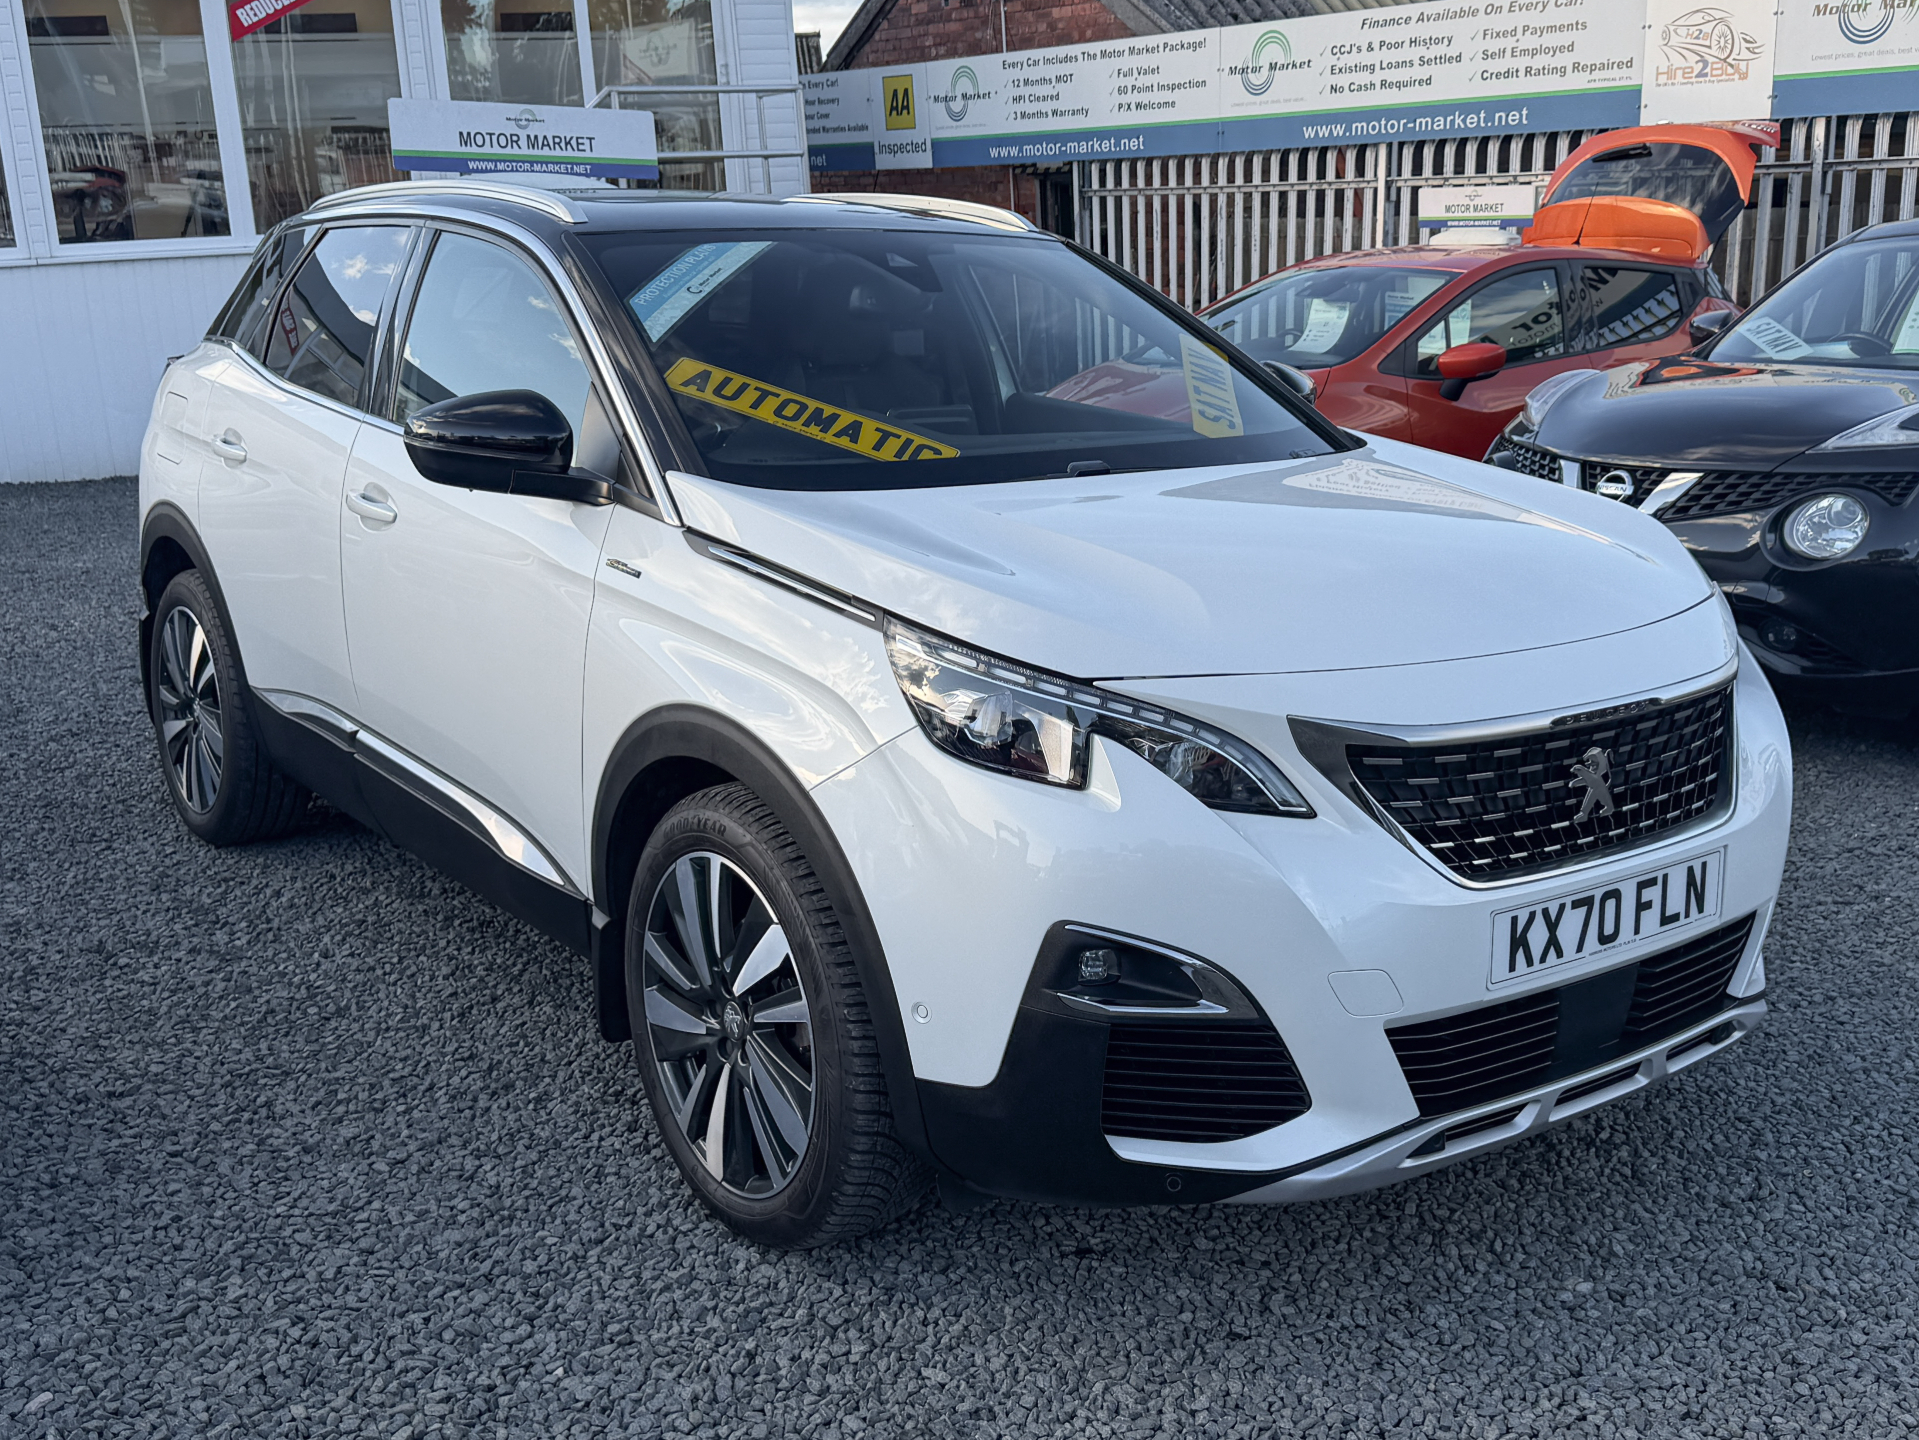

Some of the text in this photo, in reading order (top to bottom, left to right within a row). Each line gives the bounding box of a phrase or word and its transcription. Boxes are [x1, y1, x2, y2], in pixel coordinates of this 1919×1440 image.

[1361, 15, 1412, 30] Finance
[1415, 6, 1480, 24] Available
[1484, 3, 1503, 16] On
[1507, 0, 1550, 13] Every
[1812, 1, 1872, 17] Motor
[1482, 19, 1588, 41] Fixed Payments
[1002, 37, 1207, 71] Every Car Includes The Motor Market Package!
[1330, 35, 1453, 56] CCJ's & Poor History
[1481, 41, 1575, 61] Self Employed
[1117, 65, 1160, 78] Full Valet
[1228, 59, 1313, 76] Motor Market
[1330, 52, 1462, 75] Existing Loans Settled
[1480, 57, 1634, 81] Credit Rating Repaired
[1656, 59, 1749, 82] Hire2Buy
[808, 80, 824, 91] Every
[1011, 73, 1074, 88] 12 Months MOT
[1117, 78, 1207, 95] 60 Point Inspection
[1330, 75, 1433, 95] No Cash Required
[889, 88, 910, 117] AA
[933, 91, 991, 104] Motor Market
[1012, 92, 1060, 105] HPI Cleared
[1118, 100, 1176, 113] P/X Welcome
[1013, 106, 1089, 121] 3 Months Warranty
[1303, 106, 1528, 139] www.motor-market.net
[458, 131, 595, 152] MOTOR MARKET
[878, 138, 927, 158] Inspected
[989, 135, 1144, 159] www.motor-market.net
[468, 160, 591, 174] WWW.MOTOR-MARKET.NET
[1445, 203, 1504, 214] MOTOR MARKET
[635, 261, 692, 305] PROTECTION
[680, 369, 942, 460] AUTOMATIC
[1597, 483, 1627, 492] NISSAN
[1566, 701, 1649, 725] PEUGEOT
[663, 815, 727, 839] GOODYEAR
[1508, 861, 1707, 973] KX70 FLN
